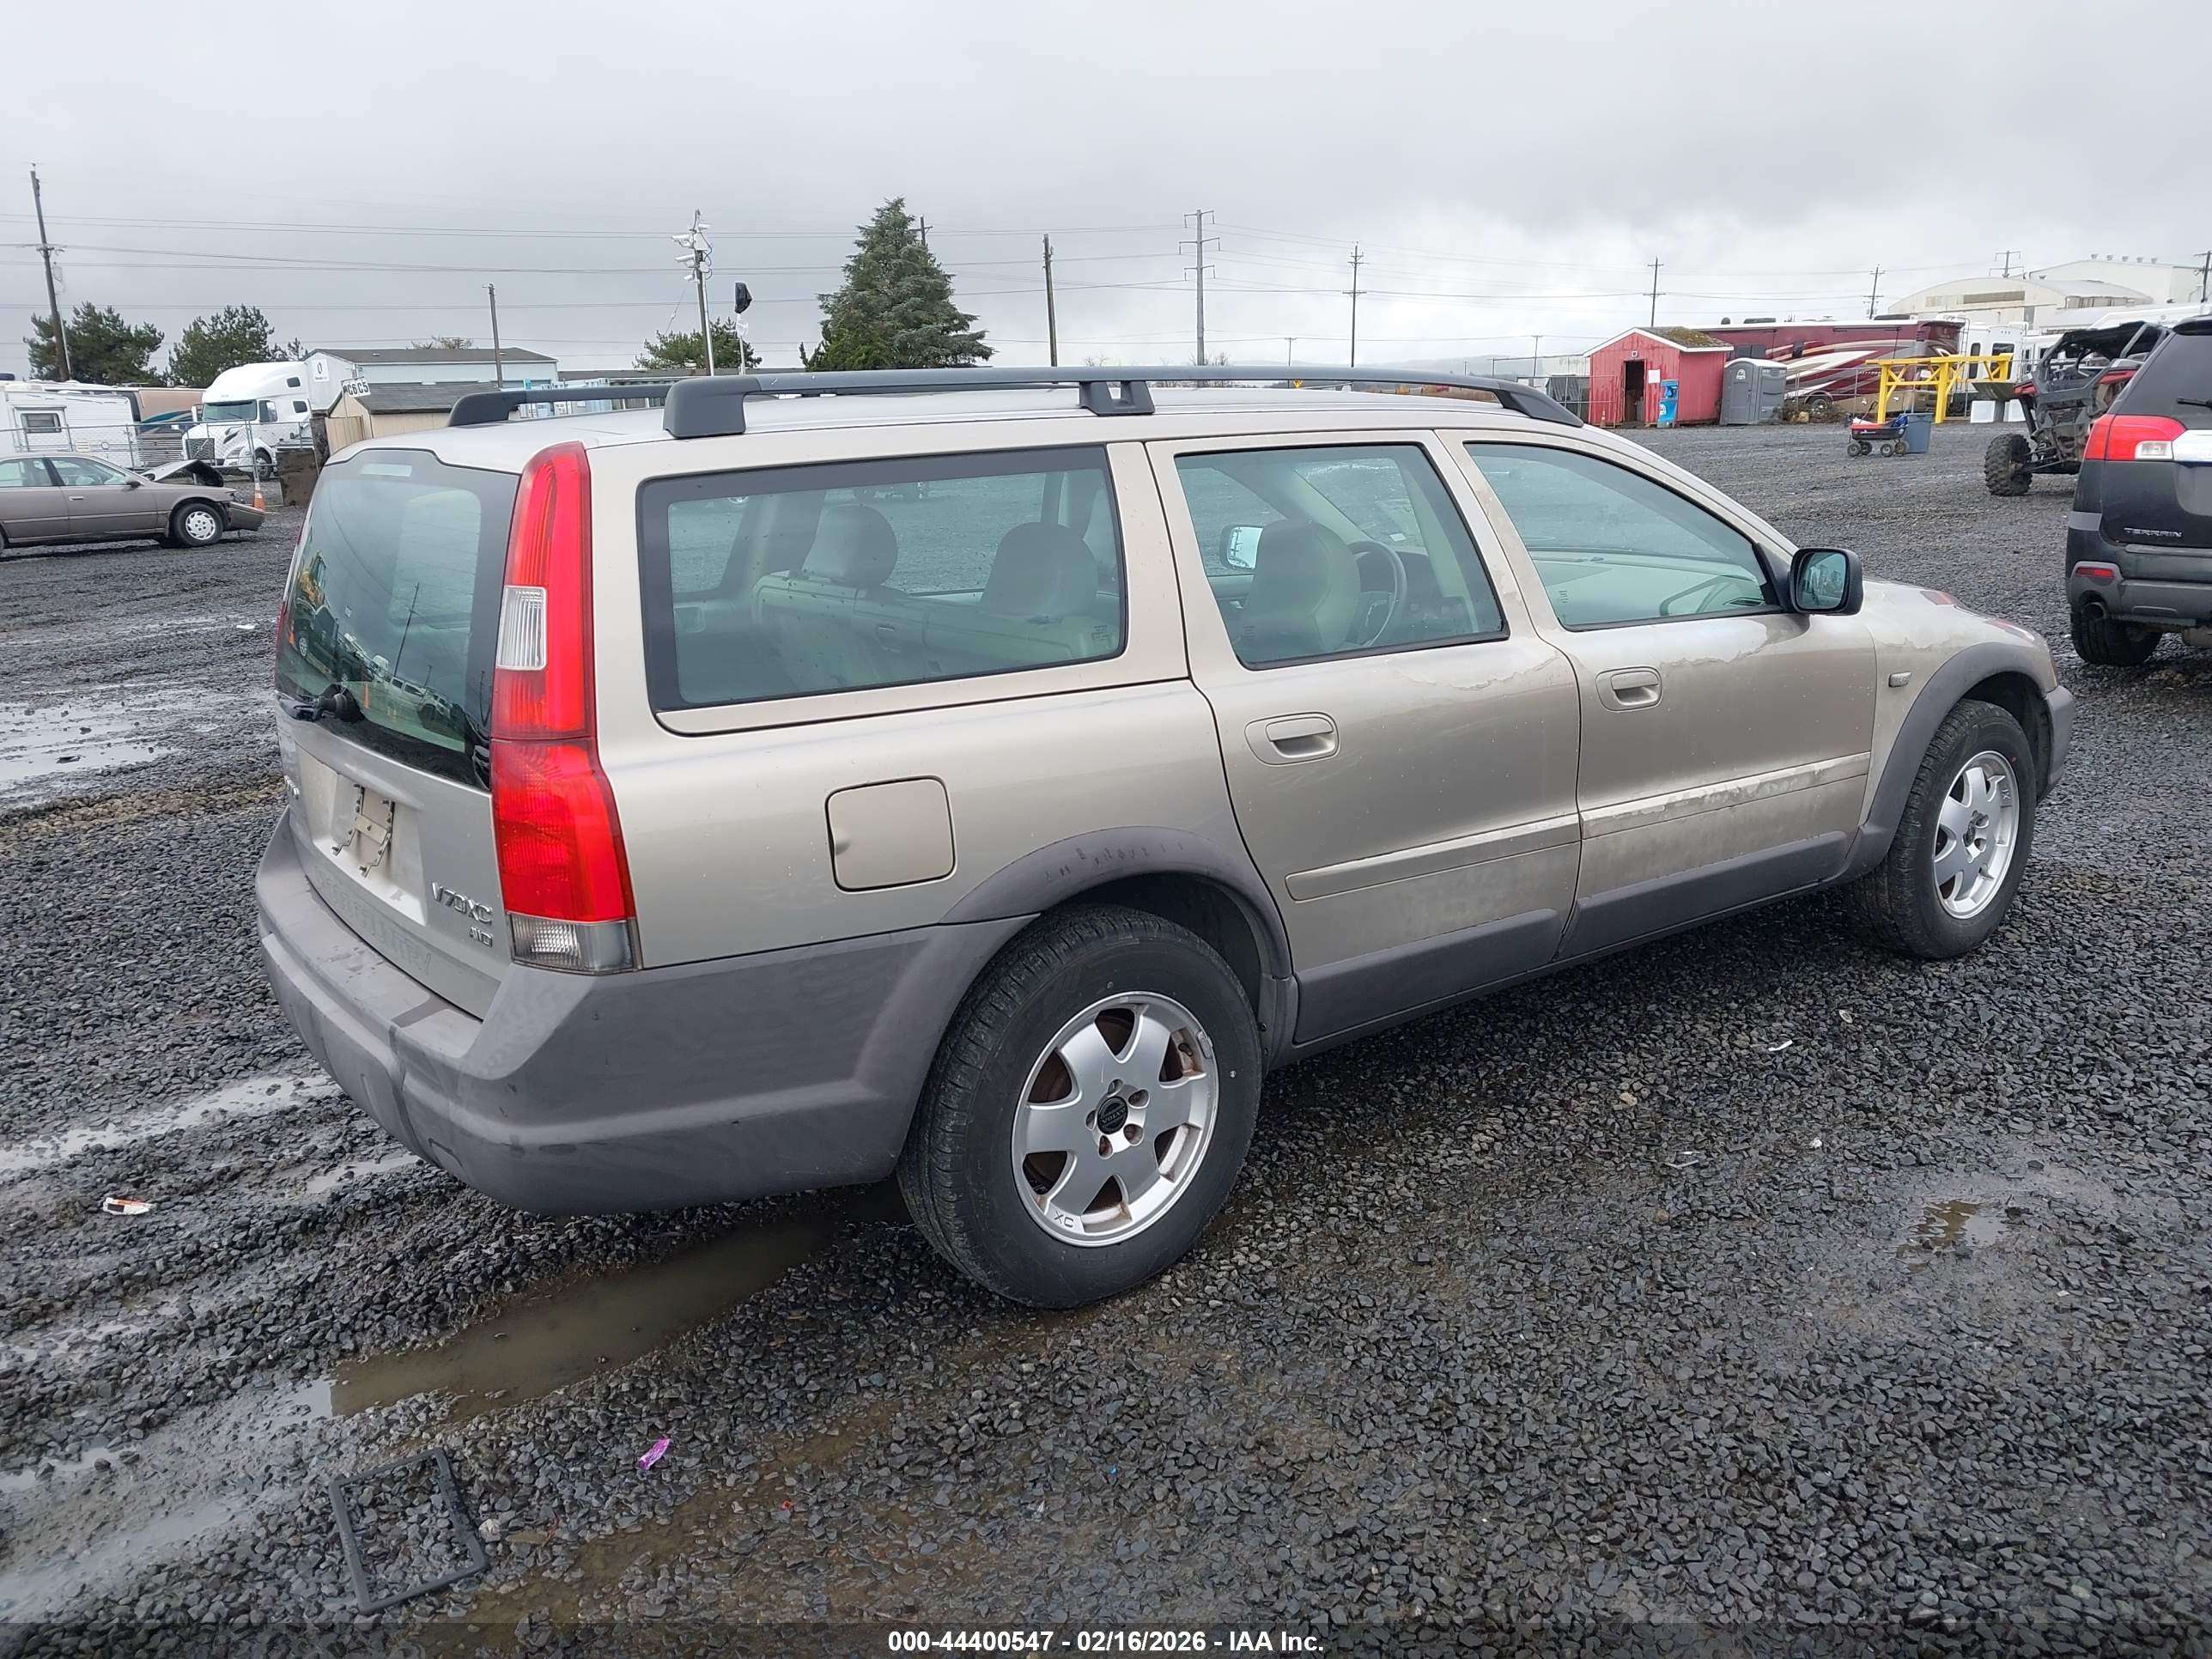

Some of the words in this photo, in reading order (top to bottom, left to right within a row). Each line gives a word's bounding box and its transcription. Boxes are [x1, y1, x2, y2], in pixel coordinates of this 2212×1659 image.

[2123, 526, 2183, 538] TERRAIN
[432, 882, 494, 925] V70XC
[469, 927, 494, 948] AWD
[1101, 1106, 1127, 1125] VOLVO
[1054, 1210, 1074, 1229] XC
